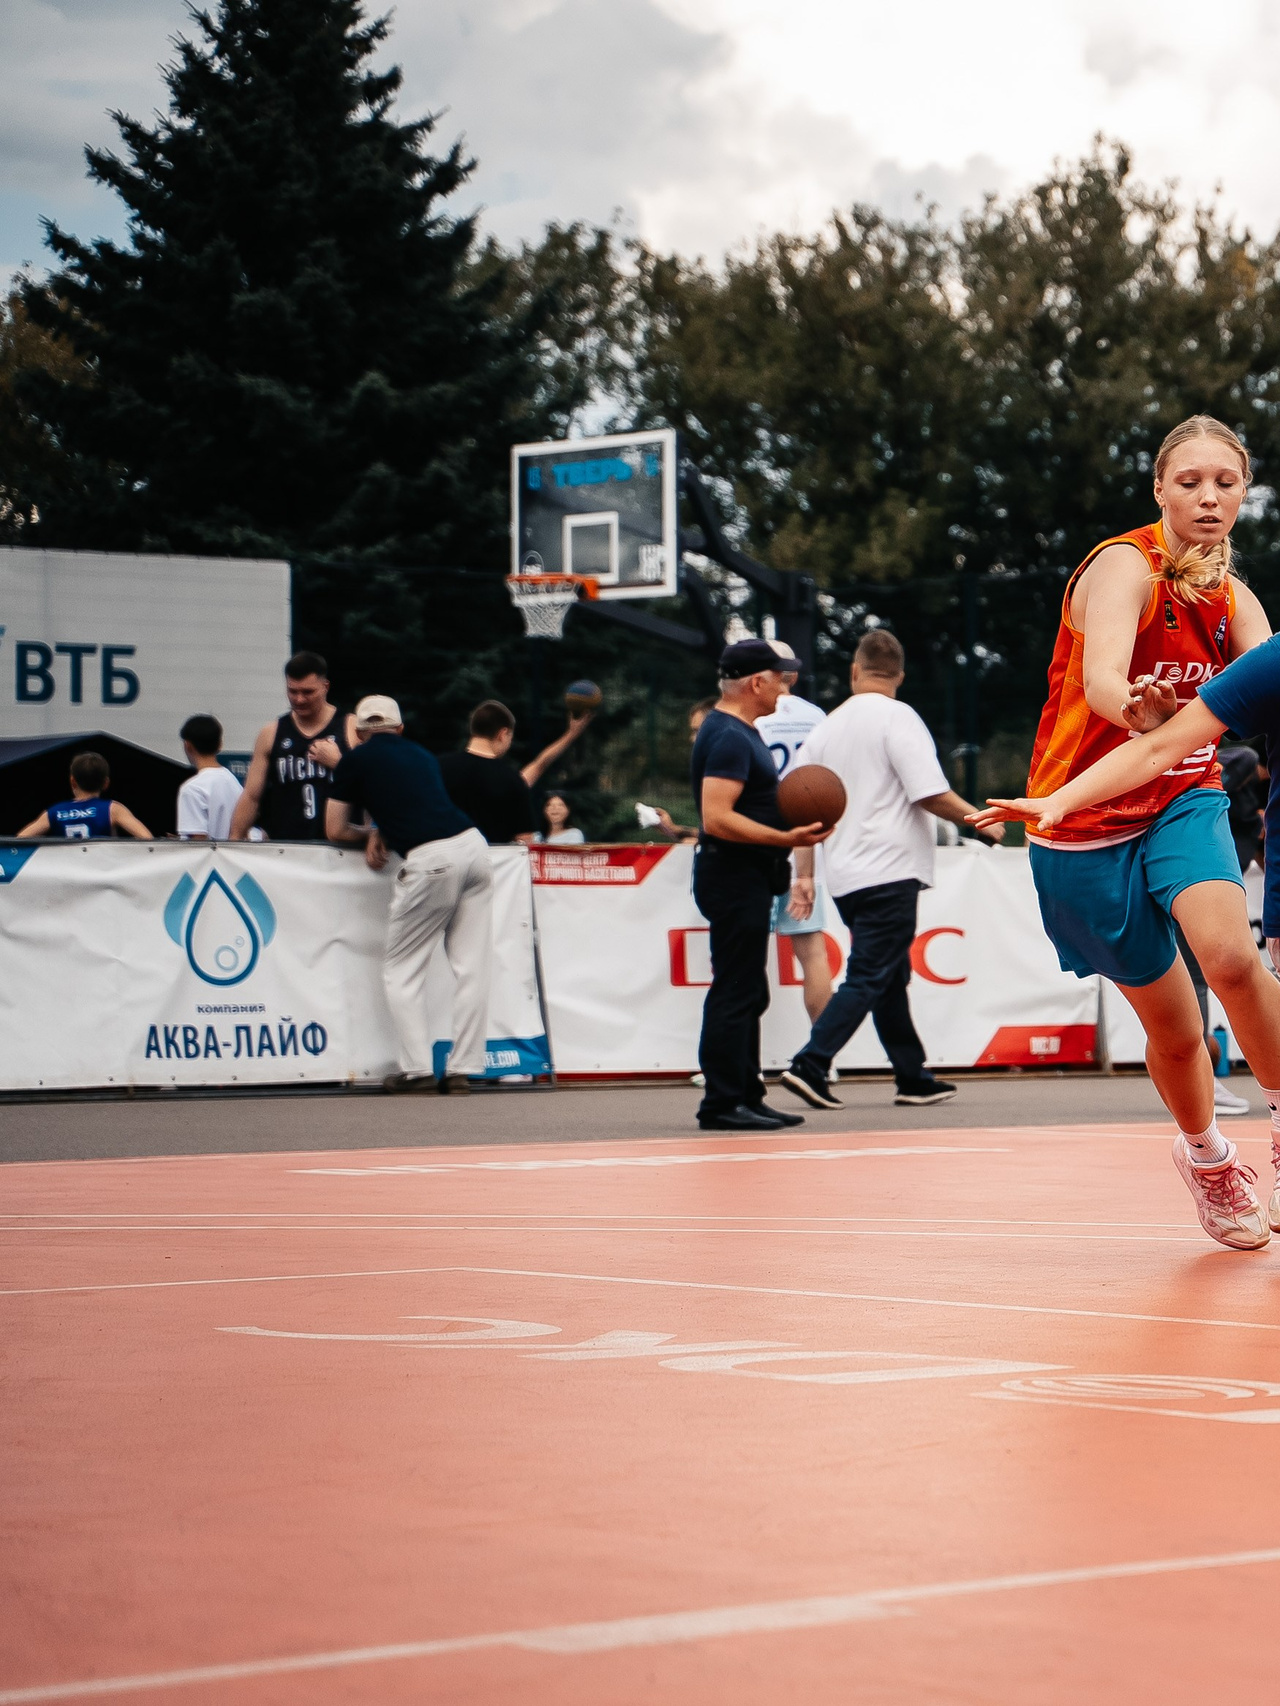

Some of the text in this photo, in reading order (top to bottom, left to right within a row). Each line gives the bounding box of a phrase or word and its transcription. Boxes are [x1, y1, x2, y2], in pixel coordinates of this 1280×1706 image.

[15, 640, 140, 708] ВТБ
[1182, 662, 1221, 683] DK
[303, 783, 316, 819] 9
[776, 926, 967, 985] DC
[196, 1003, 267, 1015] компания
[145, 1016, 328, 1059] АКВА-ЛАЙФ
